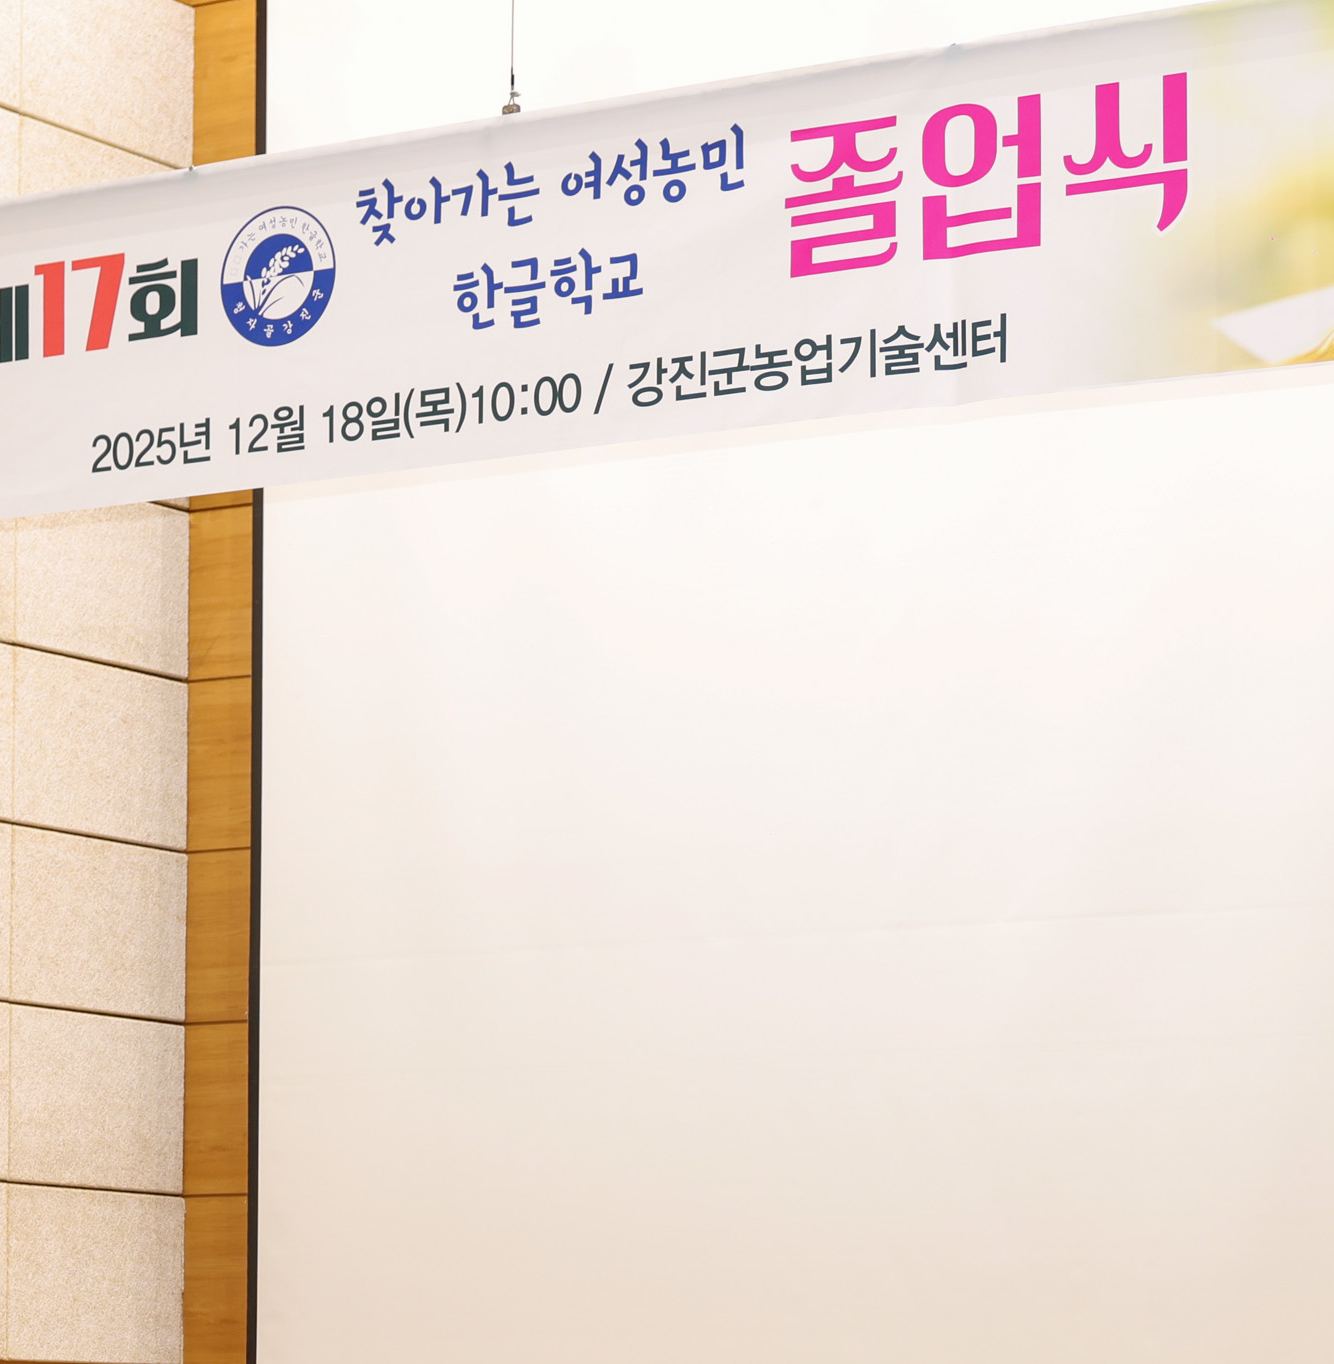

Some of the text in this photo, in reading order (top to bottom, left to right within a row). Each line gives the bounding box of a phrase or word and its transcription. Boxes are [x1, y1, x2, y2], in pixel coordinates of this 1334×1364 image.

[355, 123, 745, 246] 찾아가는 여성농민
[785, 72, 1189, 278] 졸업식
[453, 247, 644, 330] 한글학교
[91, 416, 211, 473] 2025년
[228, 404, 306, 455] 12월
[627, 313, 1008, 407] 강진군농업기술센터
